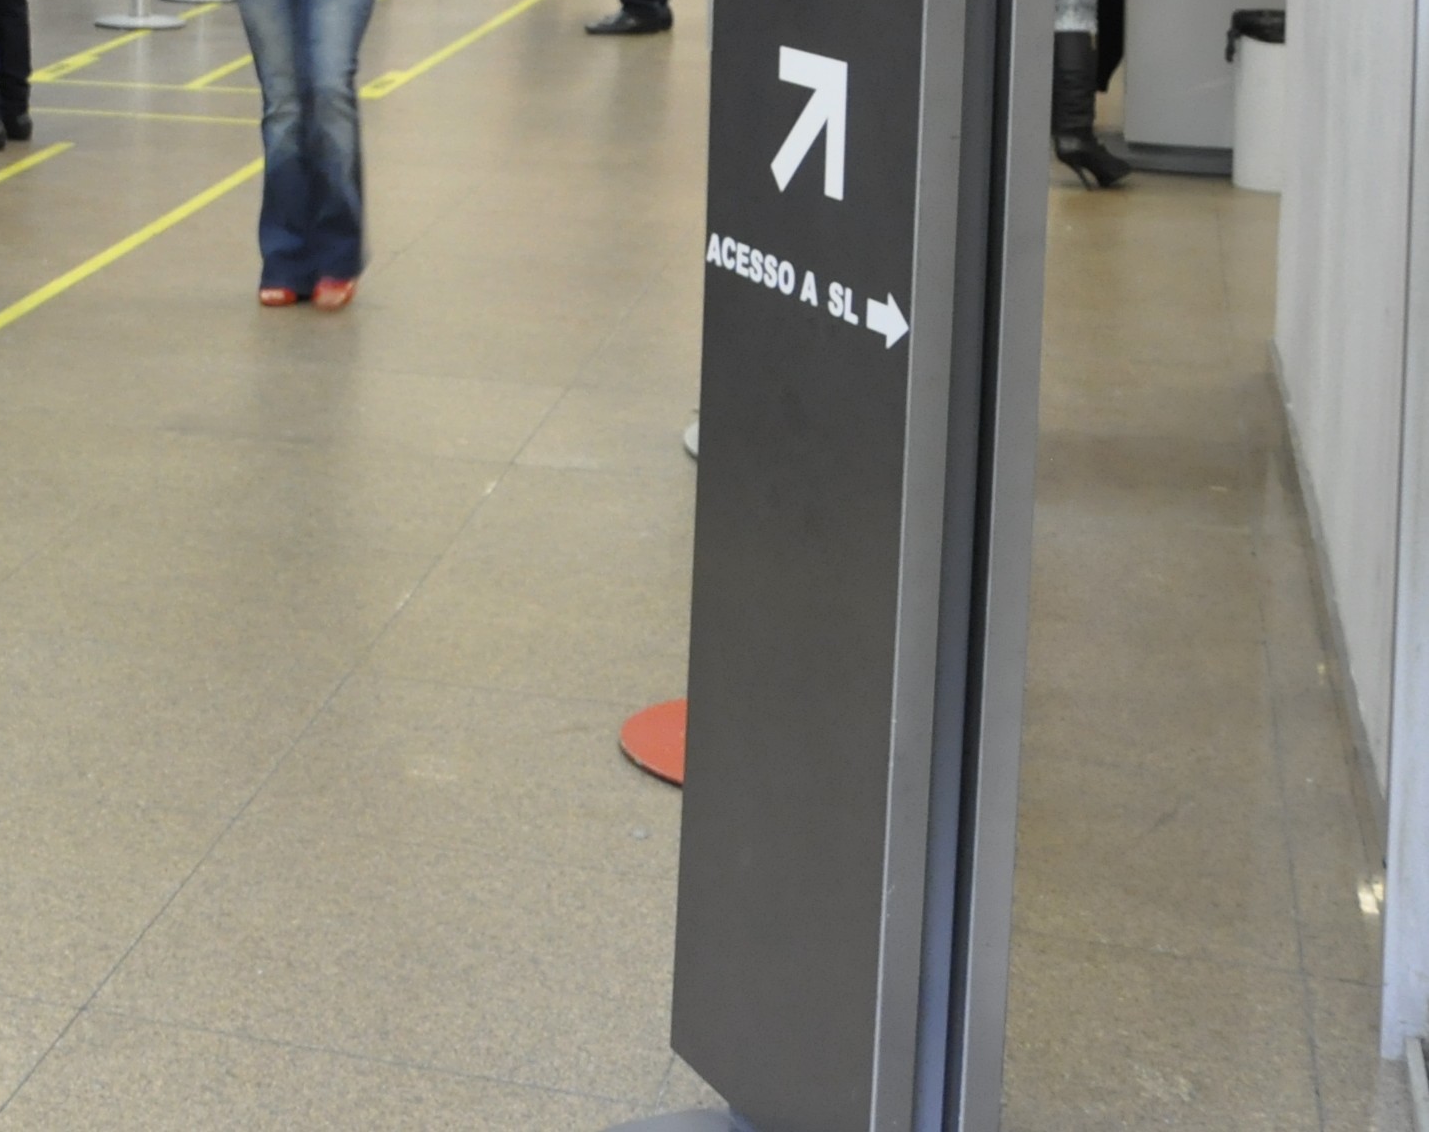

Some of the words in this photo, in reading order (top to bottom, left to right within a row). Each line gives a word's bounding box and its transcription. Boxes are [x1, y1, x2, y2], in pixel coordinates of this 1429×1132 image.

[705, 231, 796, 296] ACESSO
[799, 269, 819, 308] A
[827, 280, 860, 327] SL
